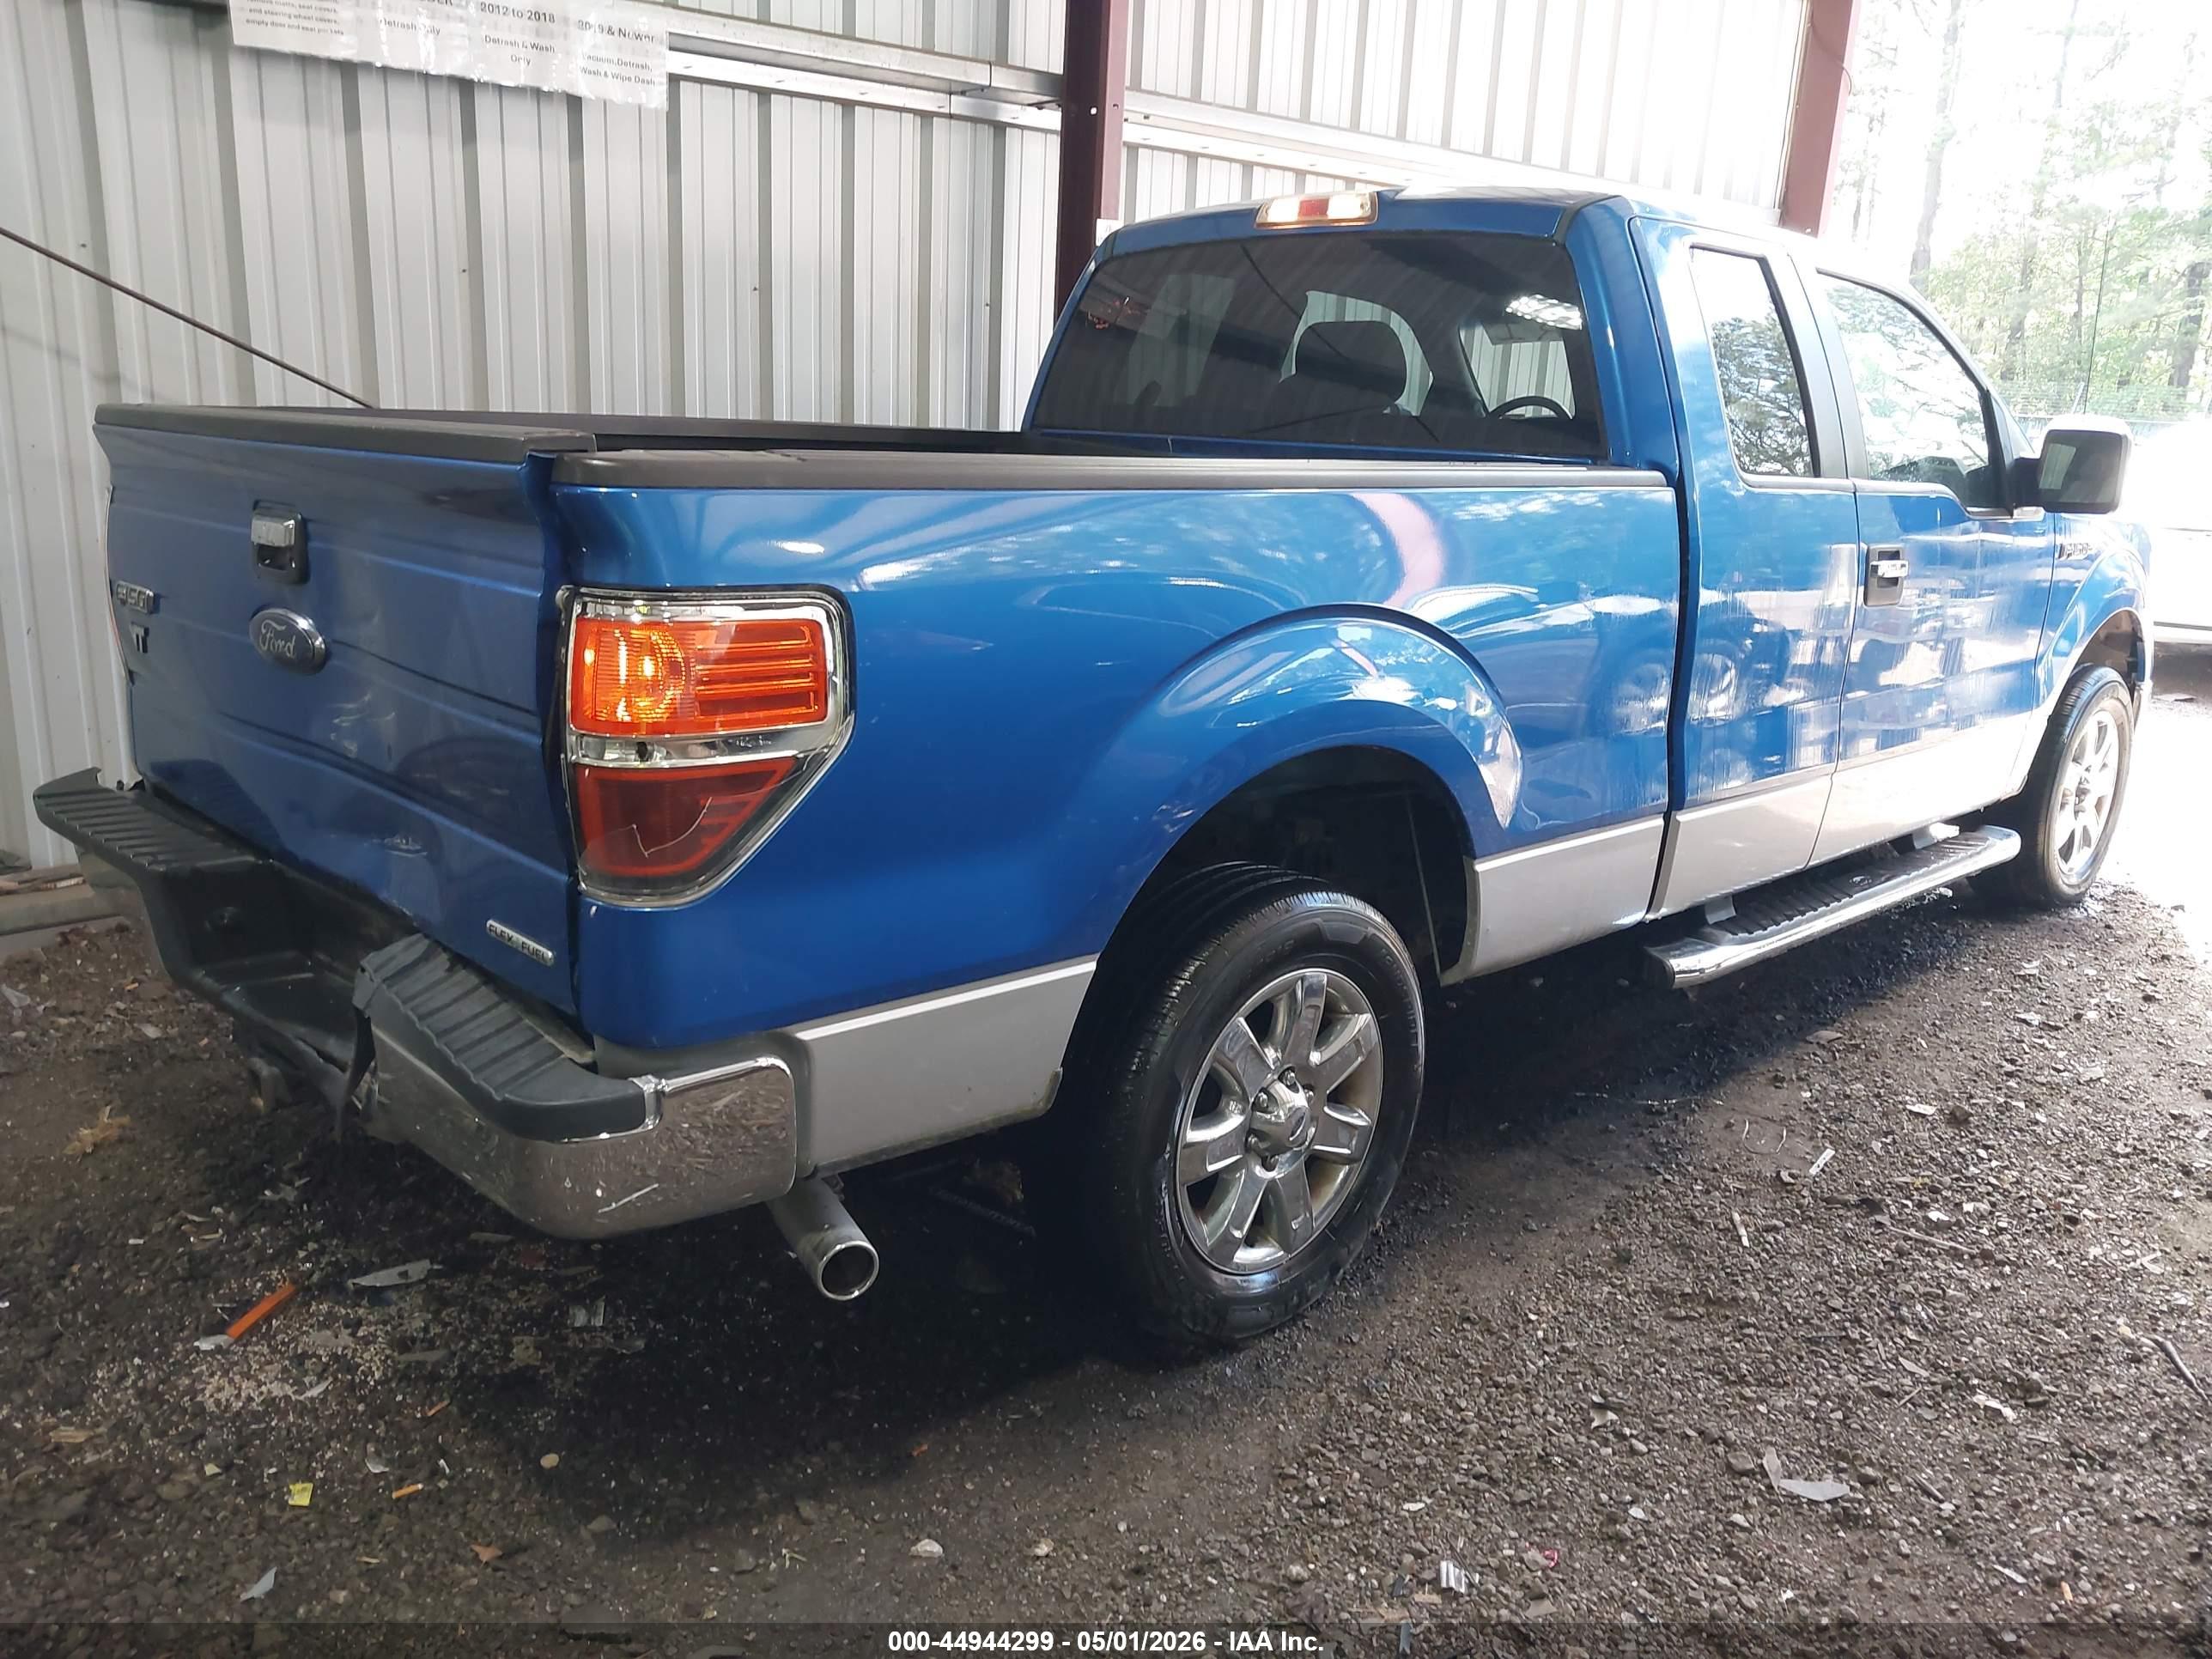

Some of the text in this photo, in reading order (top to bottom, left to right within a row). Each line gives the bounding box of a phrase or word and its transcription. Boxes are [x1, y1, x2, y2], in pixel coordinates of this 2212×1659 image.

[481, 1, 556, 24] 2012 to 2018
[607, 24, 616, 36] &
[484, 34, 520, 49] Detrash
[529, 41, 556, 53] Wash
[611, 71, 633, 82] Wipe
[634, 76, 656, 87] Dash
[260, 619, 297, 659] Ford
[521, 941, 545, 961] FUEL
